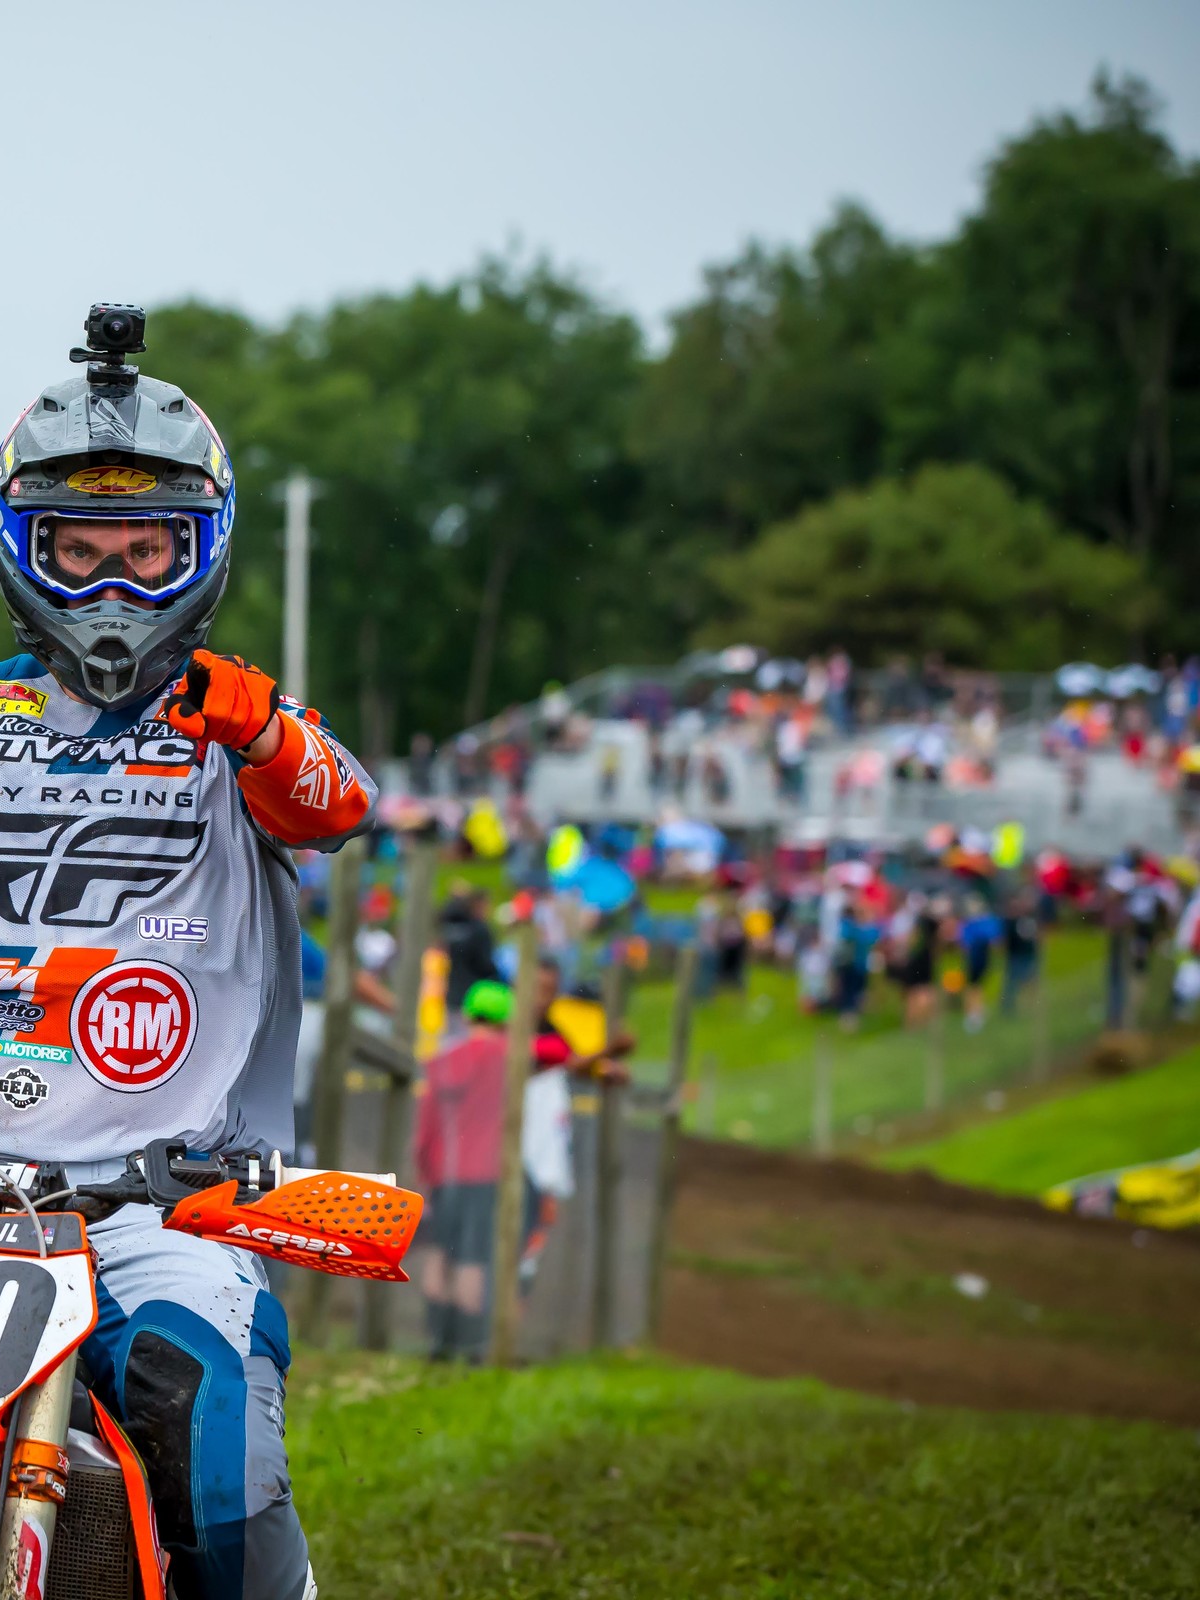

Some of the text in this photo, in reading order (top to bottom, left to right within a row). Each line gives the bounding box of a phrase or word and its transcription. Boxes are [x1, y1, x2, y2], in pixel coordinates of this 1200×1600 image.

[73, 469, 157, 487] FMF
[40, 787, 193, 807] RACING
[139, 917, 208, 942] WPS
[102, 1000, 171, 1051] RM
[3, 1042, 67, 1062] MOTOREX
[226, 1223, 352, 1257] ACERBIS
